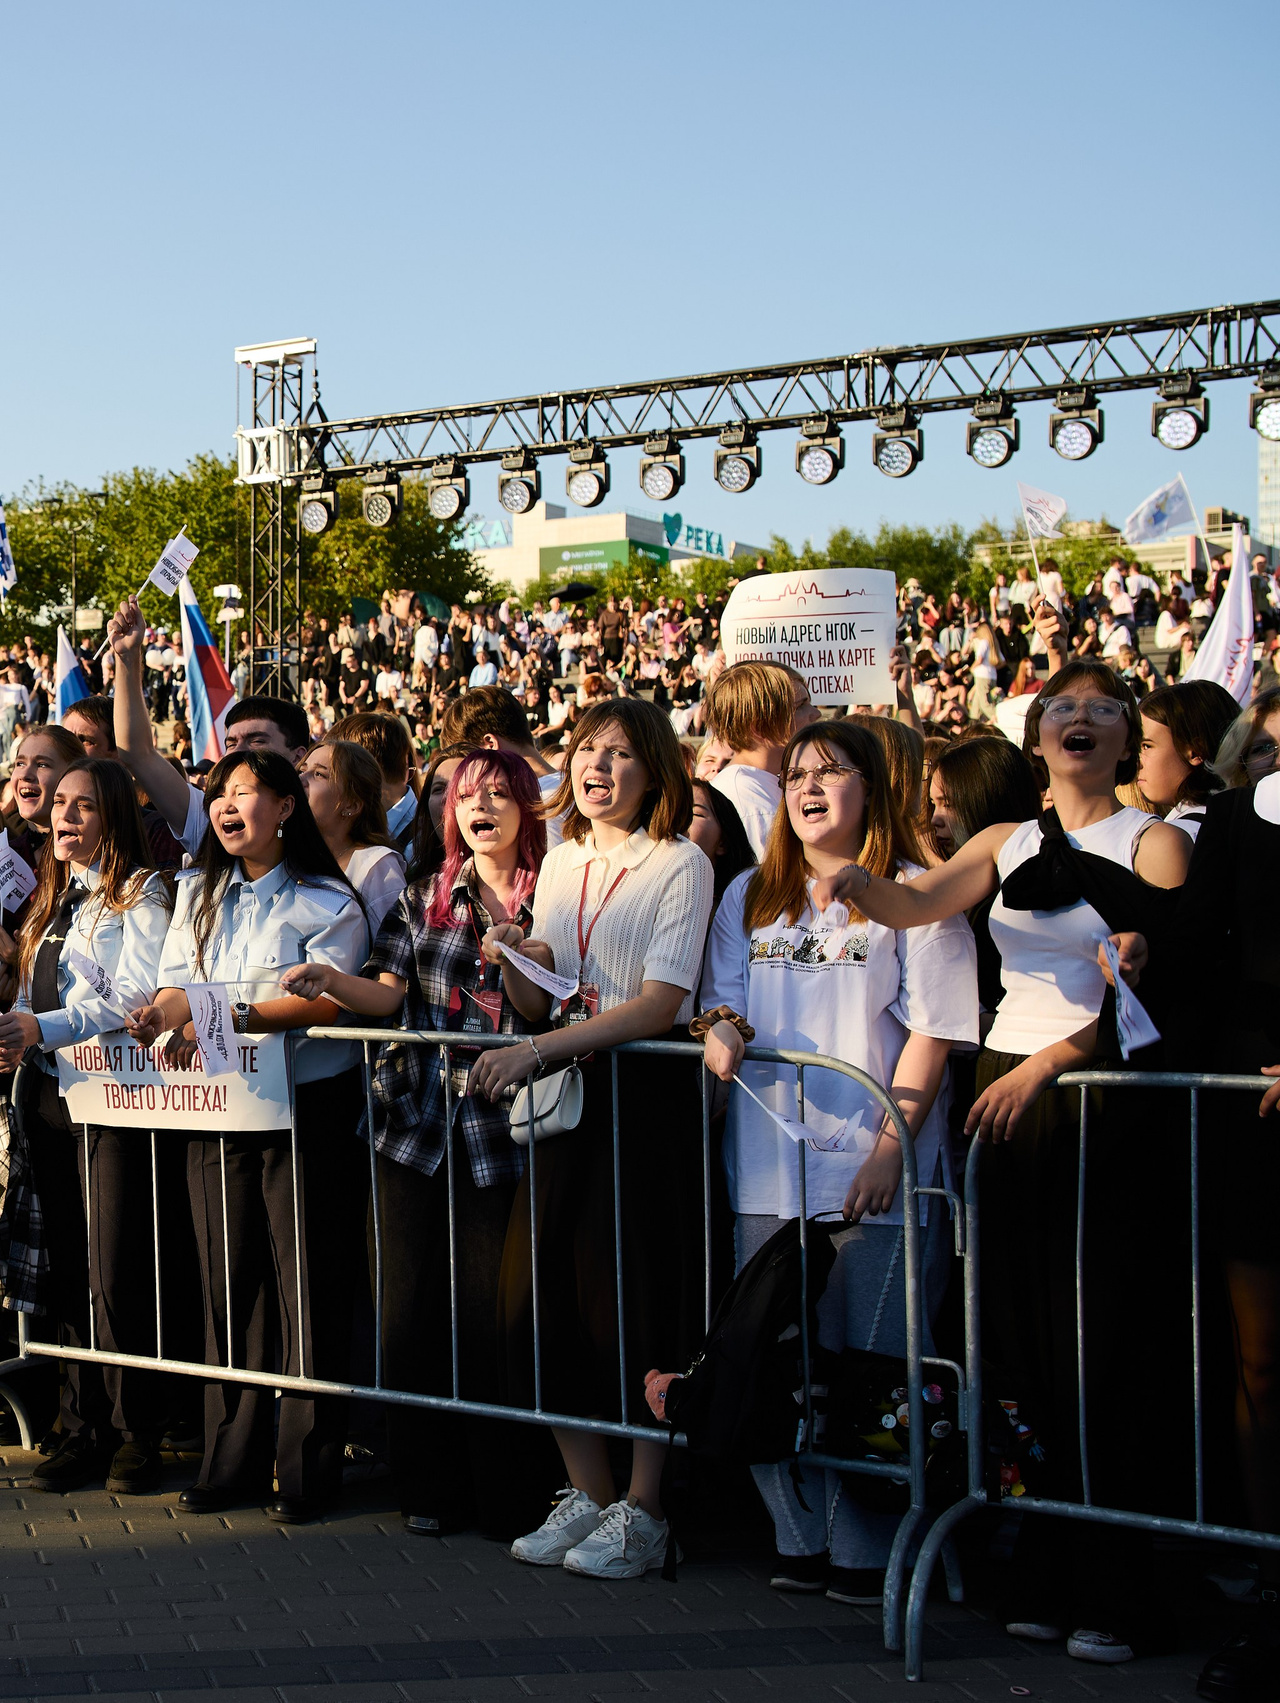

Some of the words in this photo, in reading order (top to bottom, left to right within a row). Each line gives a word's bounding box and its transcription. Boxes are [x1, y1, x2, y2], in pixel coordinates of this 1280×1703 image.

[685, 525, 725, 556] РЕКА
[736, 621, 777, 645] НОВЫЙ
[780, 624, 822, 646] АДРЕС
[826, 622, 857, 642] НГОК
[818, 650, 835, 668] НА
[838, 648, 876, 668] КАРТЕ
[73, 1046, 122, 1072] НОВАЯ
[103, 1083, 156, 1110] ТВОЕГО
[161, 1084, 227, 1112] УСПЕХА!
